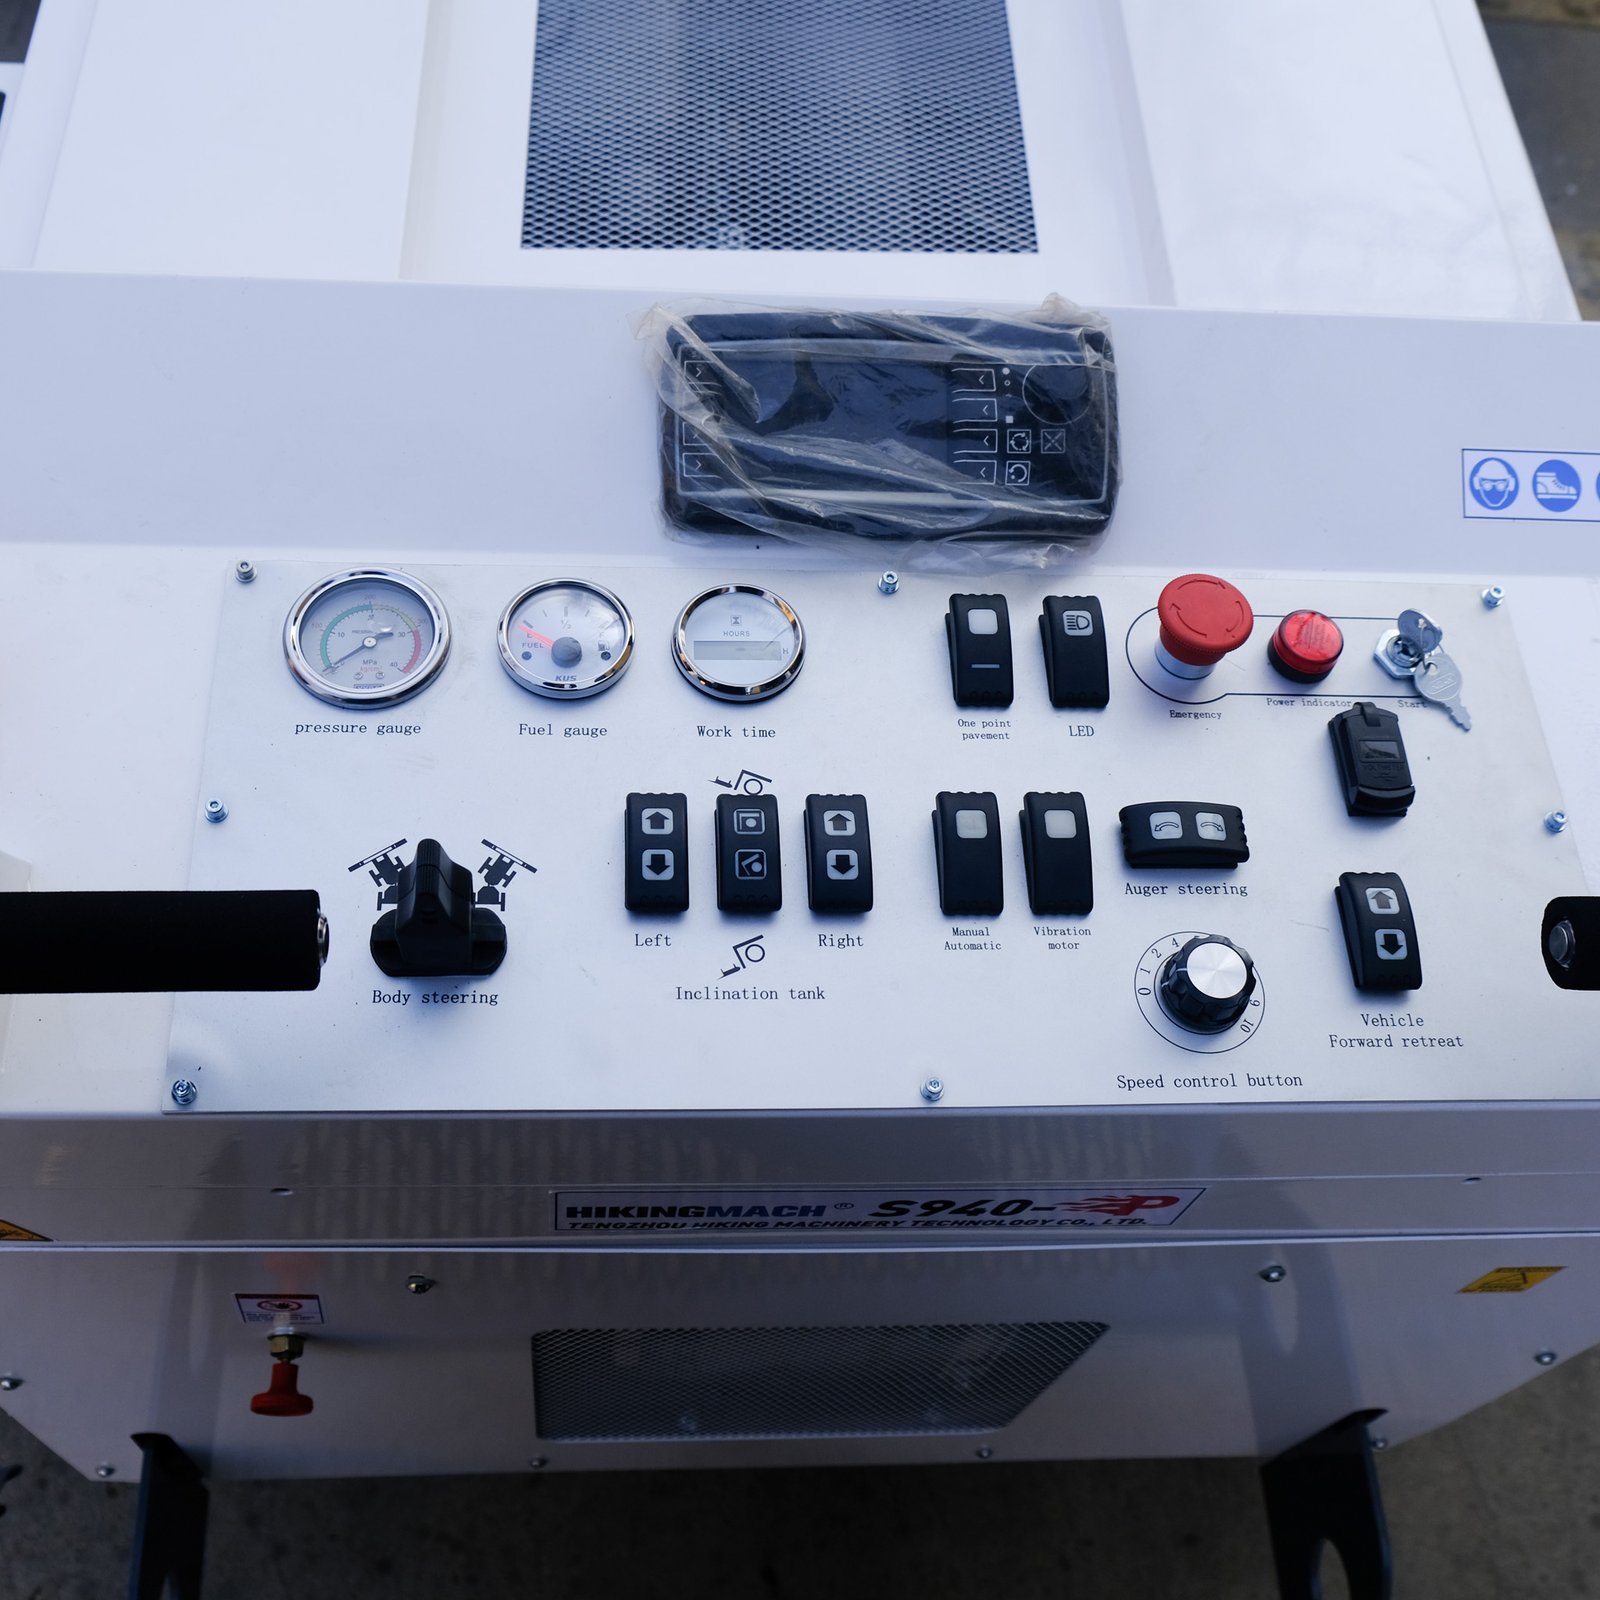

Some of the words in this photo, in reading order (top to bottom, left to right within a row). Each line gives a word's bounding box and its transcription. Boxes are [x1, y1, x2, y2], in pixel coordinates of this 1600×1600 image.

[1266, 698, 1295, 707] Power
[1301, 698, 1352, 707] indicator
[1398, 700, 1428, 708] Start
[1169, 710, 1222, 720] Emergency
[958, 719, 975, 727] One
[982, 719, 1011, 728] point
[295, 725, 367, 734] pressure
[377, 725, 421, 735] gauge
[519, 724, 552, 735] Fuel
[564, 728, 607, 738] gauge
[697, 726, 732, 737] Work
[743, 726, 775, 737] time
[1069, 725, 1094, 736] LED
[1125, 883, 1168, 897] Auger
[1178, 883, 1248, 897] steering
[952, 927, 990, 936] Manual
[1034, 927, 1091, 935] Vibration
[635, 934, 671, 946] Left
[819, 934, 863, 949] Right
[945, 941, 1001, 950] Automatic
[1171, 938, 1180, 948] 4
[1151, 948, 1162, 958] 2
[676, 986, 778, 1000] Inclination
[789, 986, 825, 999] tank
[1137, 987, 1151, 996] 0
[372, 990, 410, 1005] Body
[422, 990, 498, 1006] steering
[1239, 1018, 1254, 1033] 10
[1361, 1014, 1424, 1026] Vehicle
[1329, 1034, 1393, 1047] Forward
[1402, 1036, 1464, 1047] retreat
[1117, 1074, 1164, 1091] Speed
[1174, 1073, 1237, 1088] control
[1247, 1073, 1302, 1086] button
[692, 1221, 769, 1229] HIKING
[774, 1219, 904, 1228] MACHINERY
[911, 1218, 1055, 1227] TECHNOLOGY
